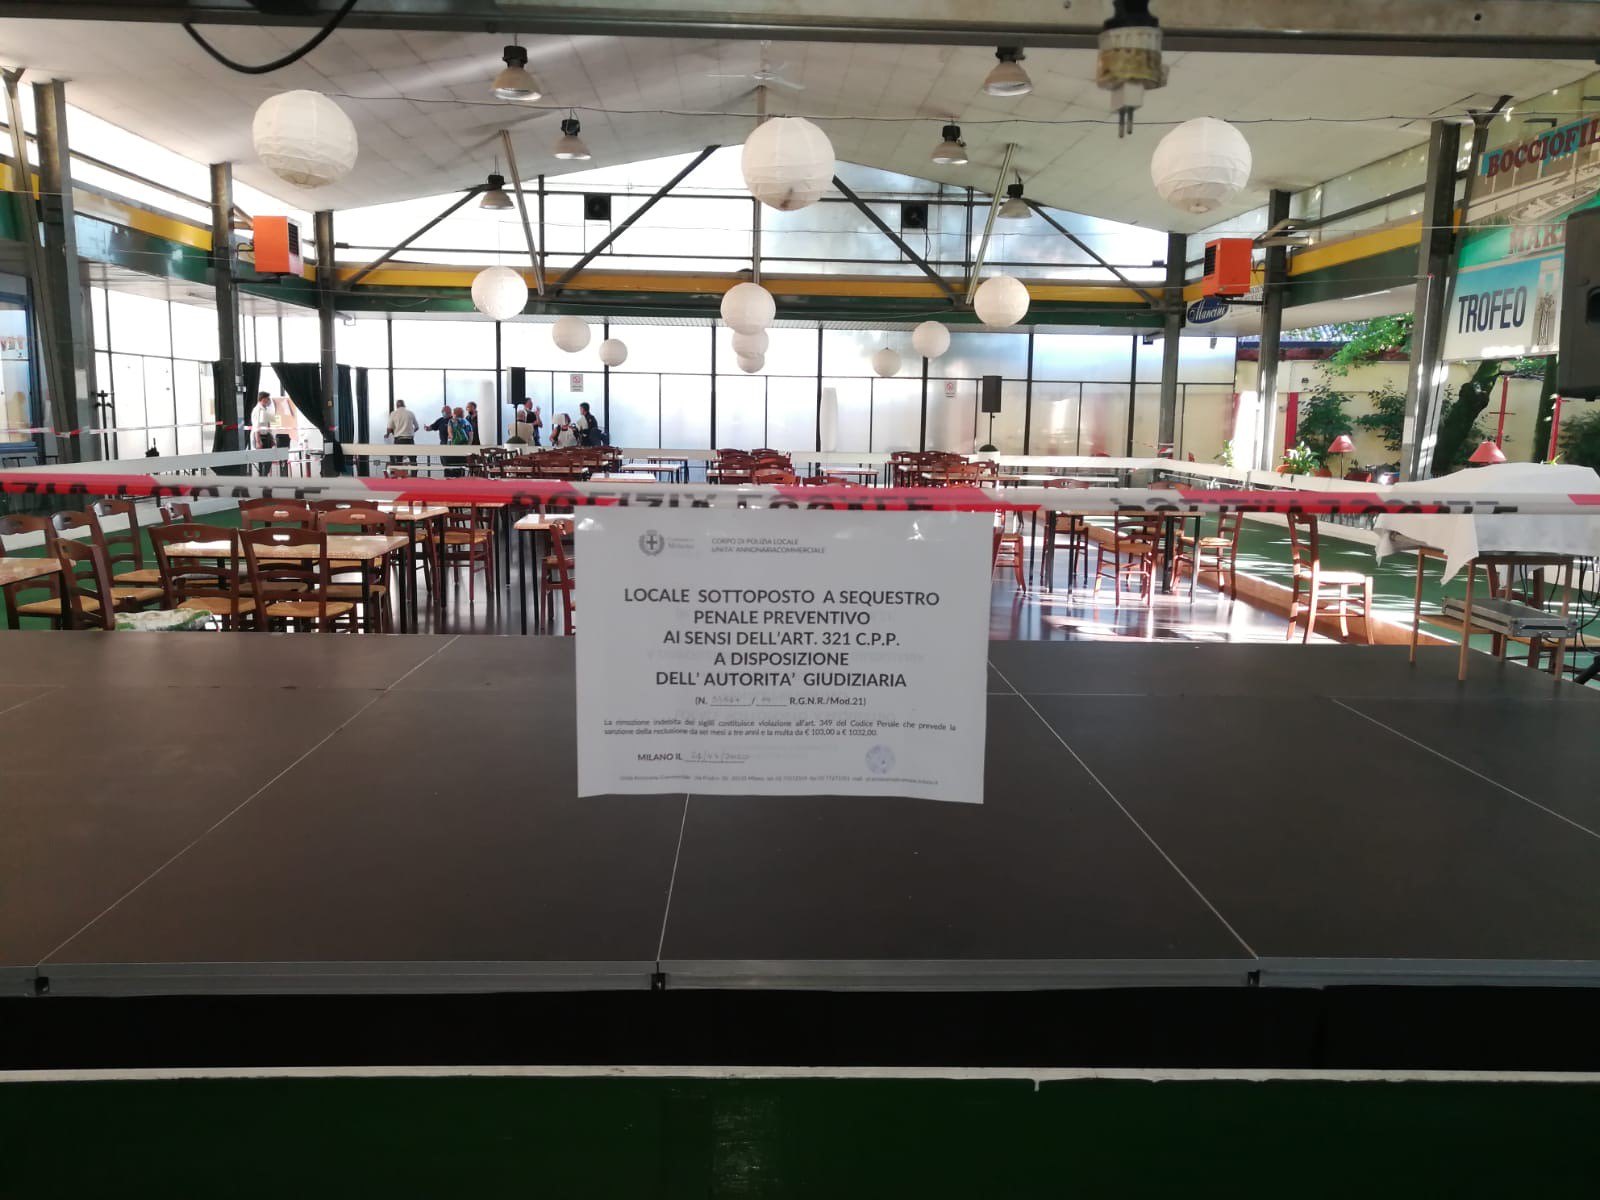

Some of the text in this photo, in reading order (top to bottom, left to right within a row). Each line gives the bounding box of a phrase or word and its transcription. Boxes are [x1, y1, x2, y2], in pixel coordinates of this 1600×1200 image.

[1457, 285, 1528, 334] TROFEO
[746, 537, 772, 545] POLIZIA
[773, 537, 799, 546] LOCALE
[625, 588, 939, 607] LOCALE SOTTOPOSTO A SEQUESTRO
[694, 610, 870, 625] PENALE PREVENTIVO
[663, 630, 899, 646] AI SENSI DELL'ART. 321 C.P.P.
[714, 652, 849, 666] A DISPOSIZIONE
[656, 672, 907, 687] DELL' AUTORITA' GIUDIZIARIA
[850, 719, 873, 727] Codice
[637, 752, 673, 761] MILANO
